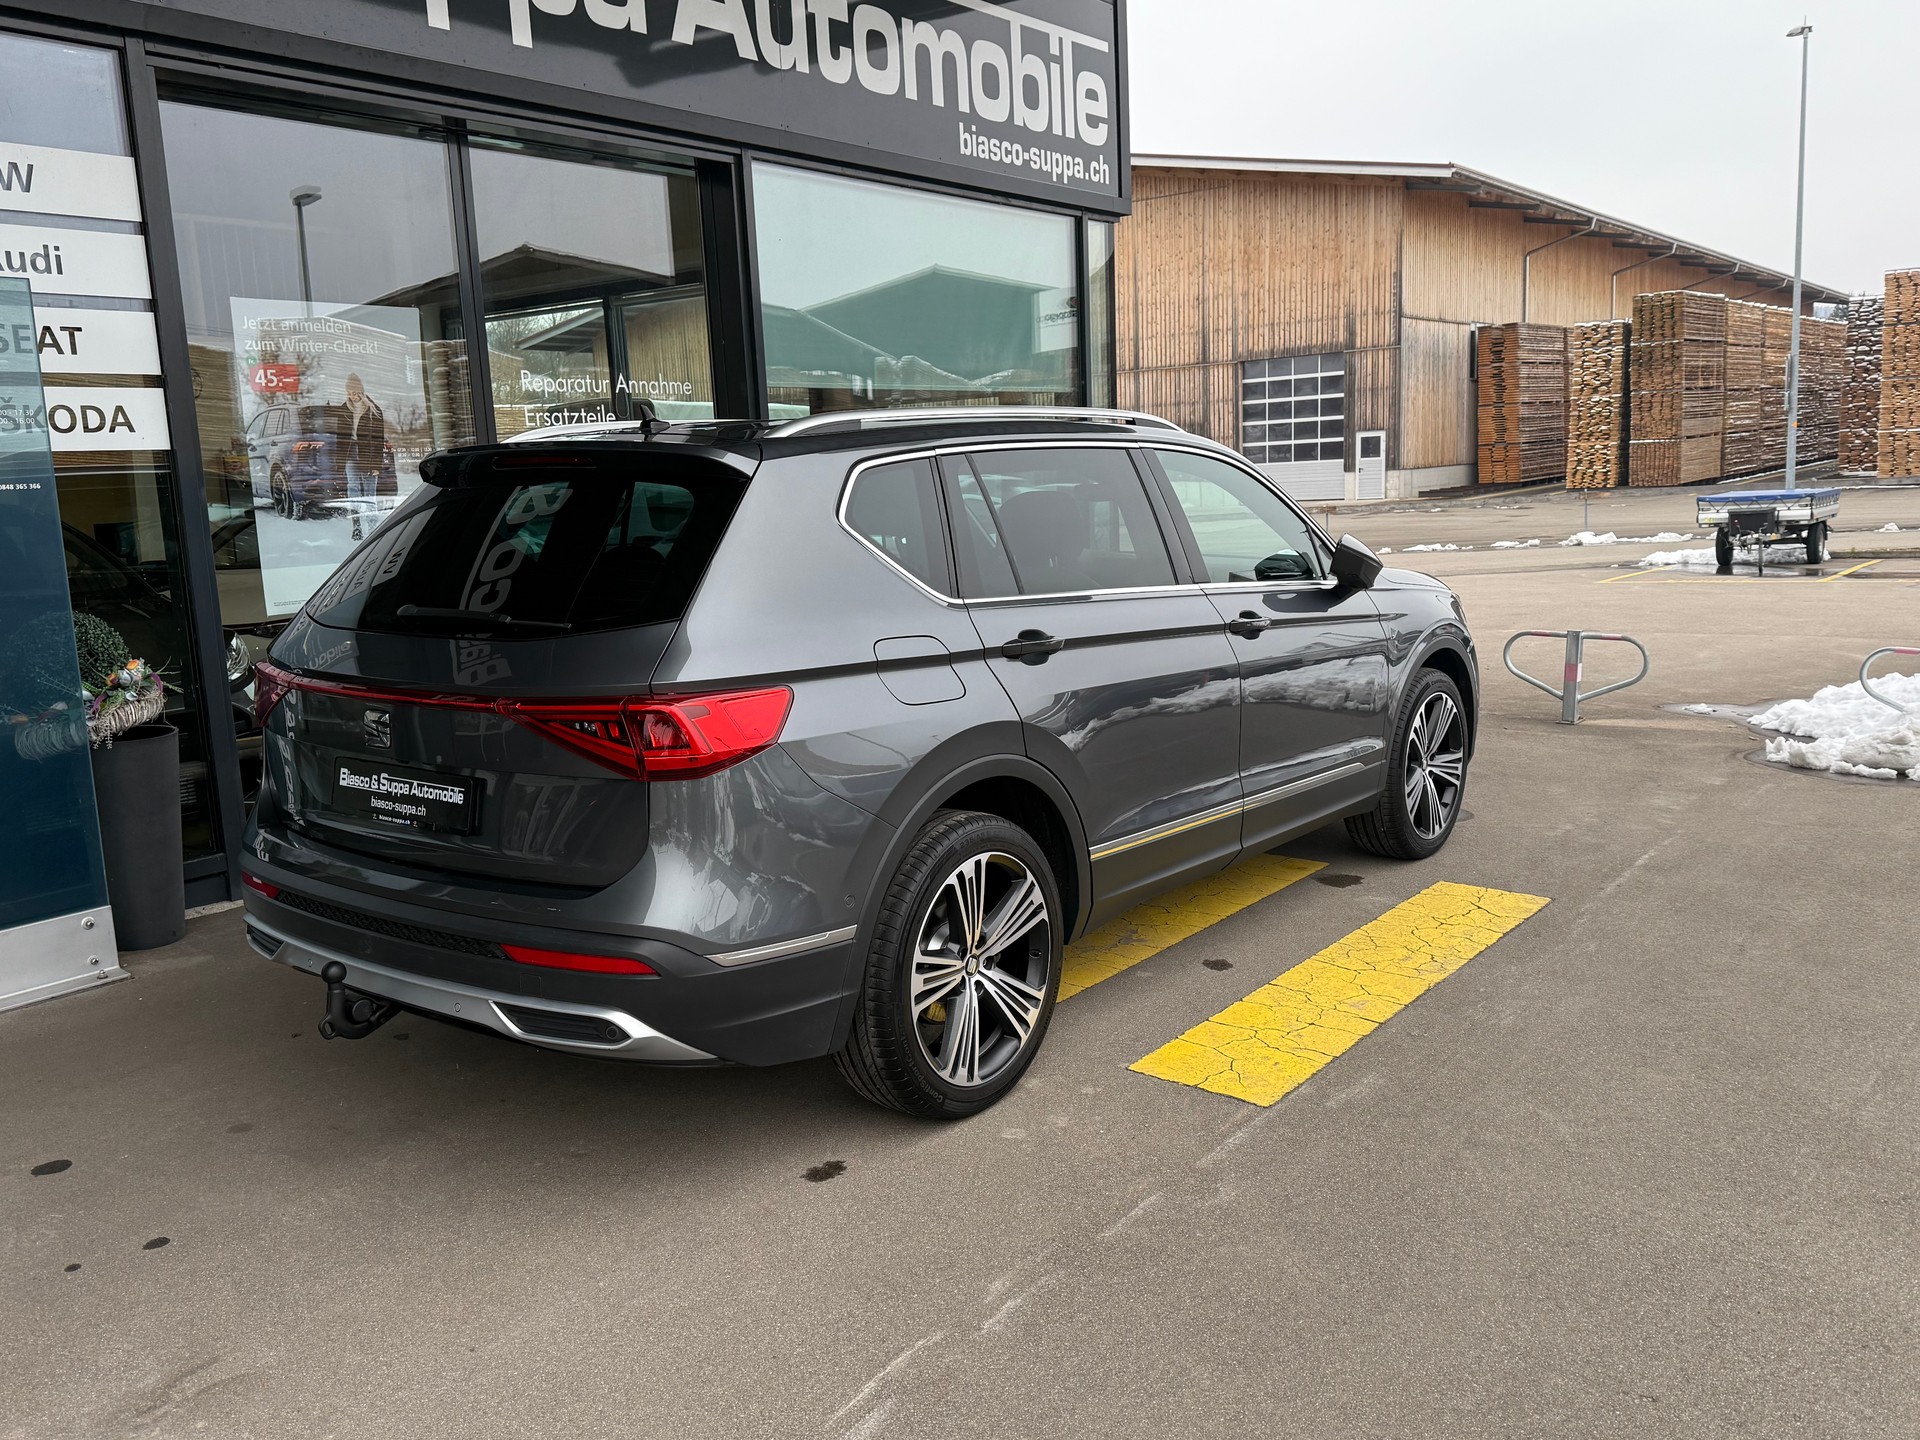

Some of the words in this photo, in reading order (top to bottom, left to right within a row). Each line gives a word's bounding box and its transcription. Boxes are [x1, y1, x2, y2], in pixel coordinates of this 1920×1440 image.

[959, 122, 1110, 185] biasco-suppa.ch
[0, 244, 63, 275] udi
[242, 316, 278, 331] Jetzt
[281, 319, 351, 334] anmelden
[244, 338, 275, 351] zum
[279, 338, 378, 354] Winter-Check!
[520, 370, 610, 398] Reparatur
[616, 373, 692, 395] Annahme
[524, 404, 616, 426] Ersatzteile
[339, 767, 370, 788] Biasco
[371, 774, 379, 789] &
[379, 773, 410, 797] Suppa
[410, 781, 464, 804] Automobile
[370, 796, 427, 817] biasco-suppa.ch
